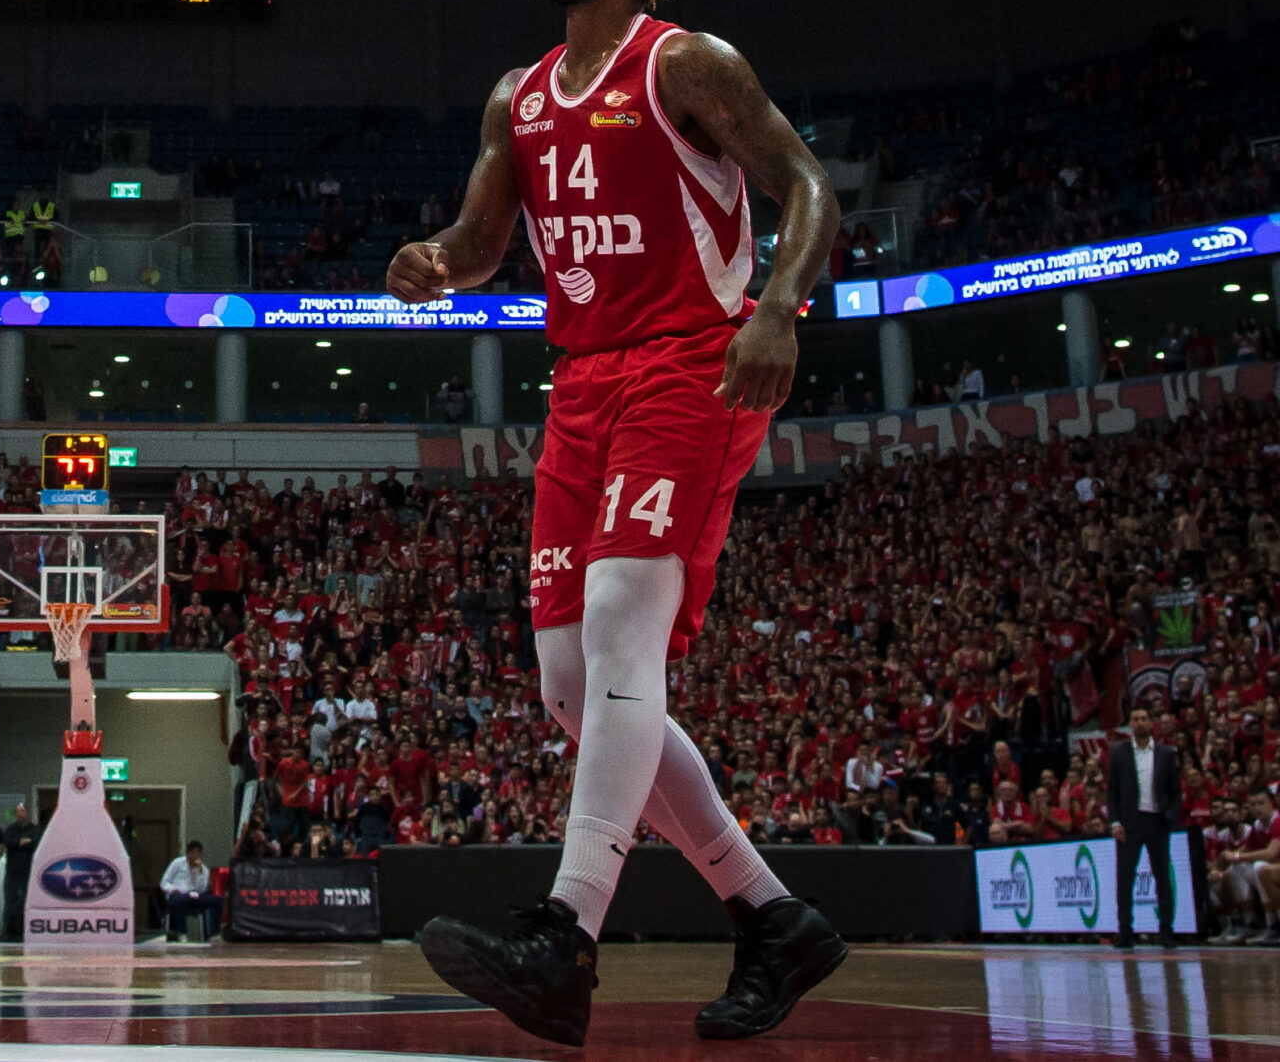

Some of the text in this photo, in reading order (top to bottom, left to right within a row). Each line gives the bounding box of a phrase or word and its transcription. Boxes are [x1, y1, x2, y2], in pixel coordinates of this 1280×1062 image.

[539, 144, 599, 201] 14
[571, 214, 645, 264] בנק
[1192, 233, 1236, 252] מכבי
[299, 298, 354, 311] הראשית
[846, 290, 861, 310] 1
[264, 309, 324, 325] בירושלים
[327, 312, 384, 325] והספורט
[501, 304, 543, 318] מכבי
[603, 474, 675, 538] 14
[324, 888, 371, 906] ארומה
[29, 918, 128, 934] SUBARU
